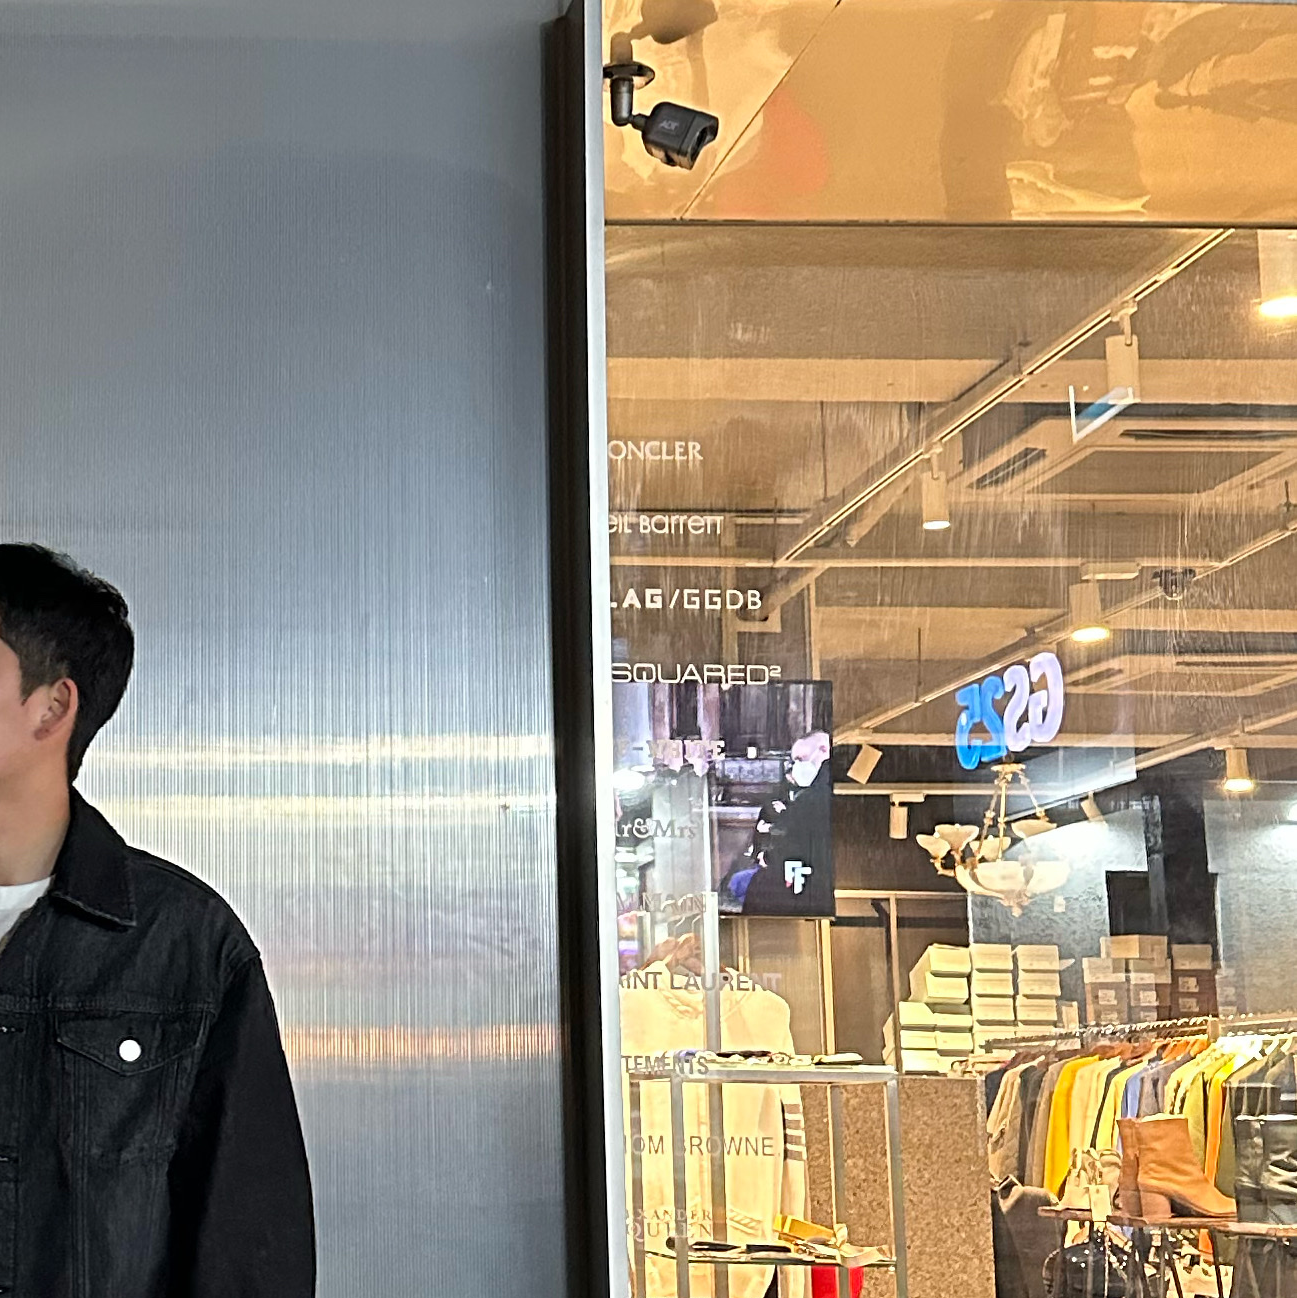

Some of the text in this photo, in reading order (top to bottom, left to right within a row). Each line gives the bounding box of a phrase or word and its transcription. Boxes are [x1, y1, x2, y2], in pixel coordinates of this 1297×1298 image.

[610, 587, 763, 610] AG/GGDB
[670, 972, 782, 992] LAURENT
[624, 1134, 665, 1155] OM
